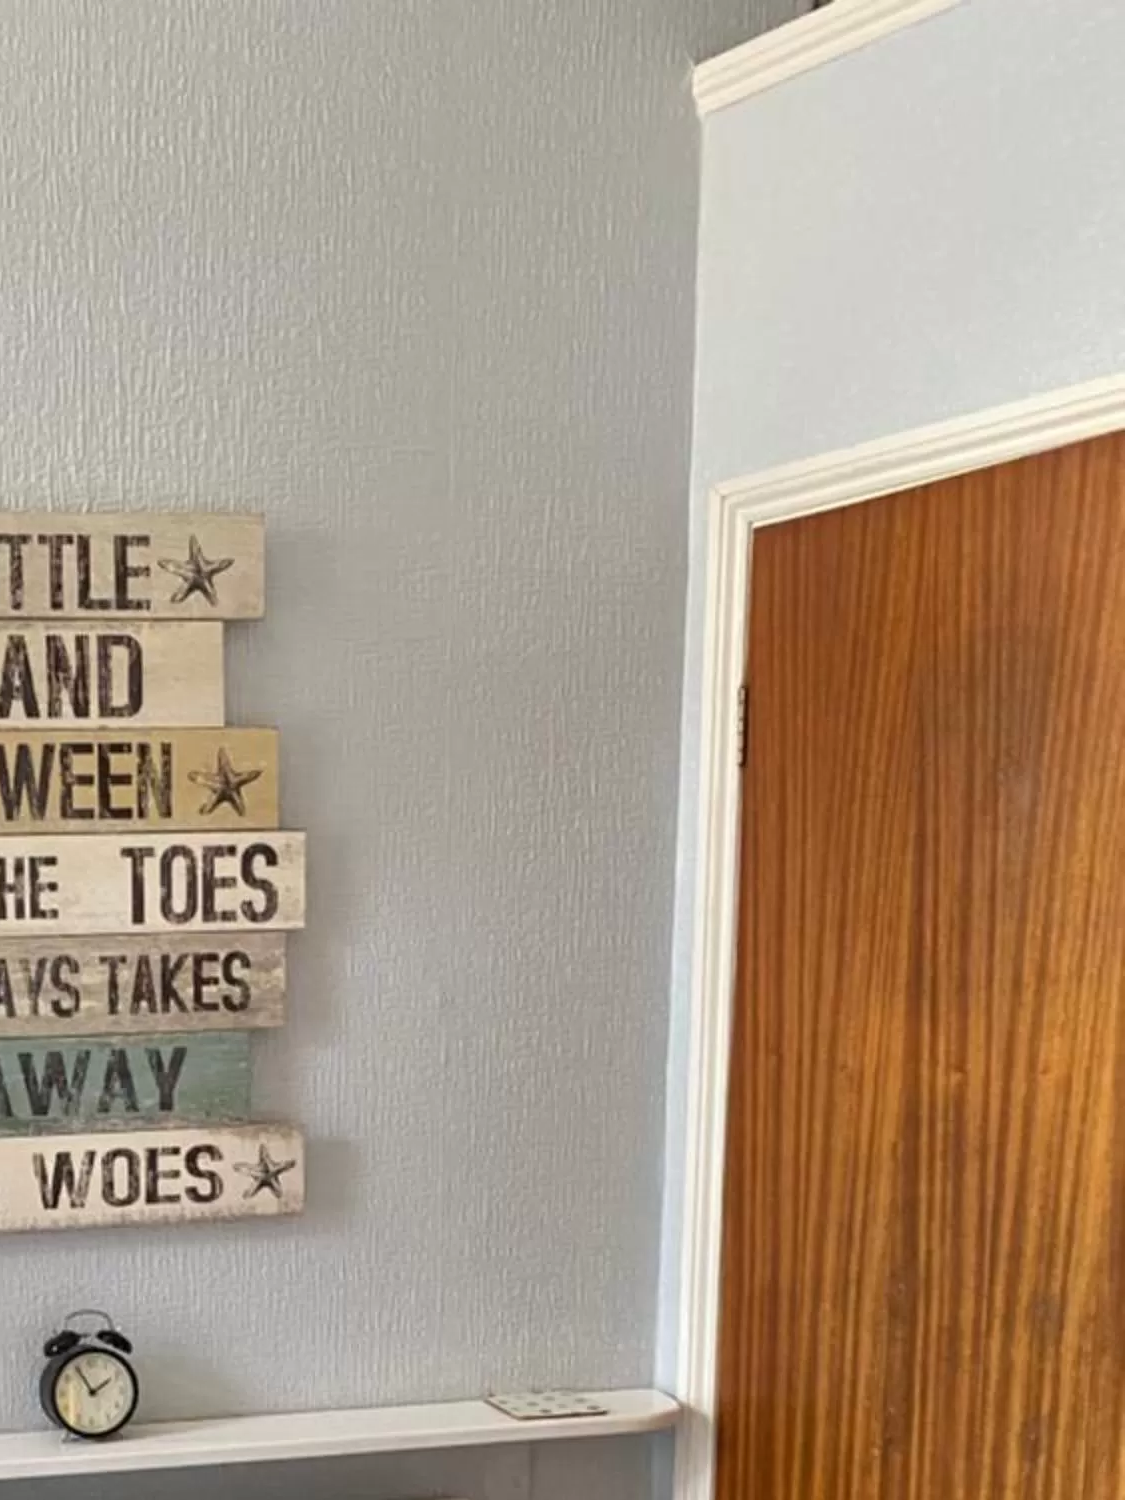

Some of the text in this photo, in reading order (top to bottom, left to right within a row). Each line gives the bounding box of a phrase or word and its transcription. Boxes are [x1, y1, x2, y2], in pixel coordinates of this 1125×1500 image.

[121, 843, 278, 924] TOES
[99, 951, 251, 1015] TAKES
[33, 1144, 223, 1209] WOES
